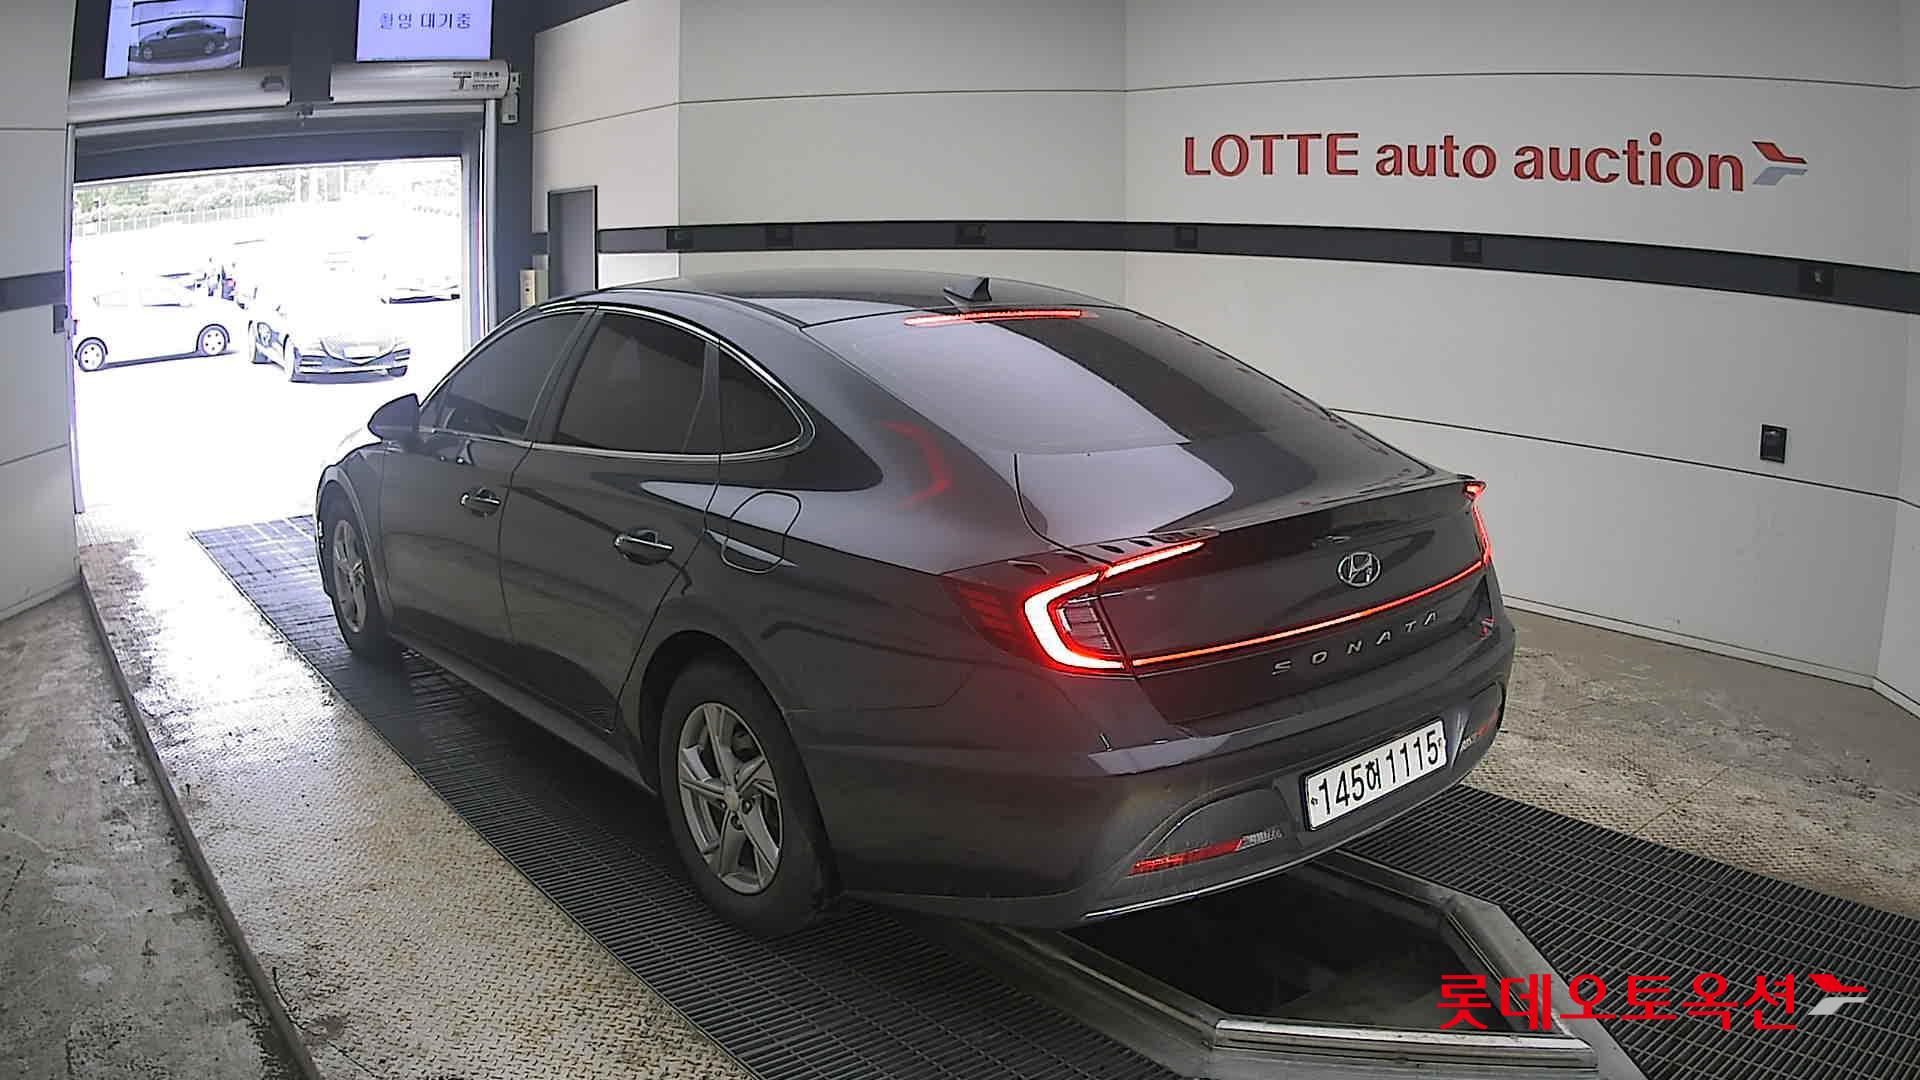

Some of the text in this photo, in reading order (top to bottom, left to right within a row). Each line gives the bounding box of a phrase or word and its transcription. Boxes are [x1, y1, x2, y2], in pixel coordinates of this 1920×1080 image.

[1184, 132, 1744, 191] LOTTE auto auction
[1272, 611, 1437, 675] SONATA
